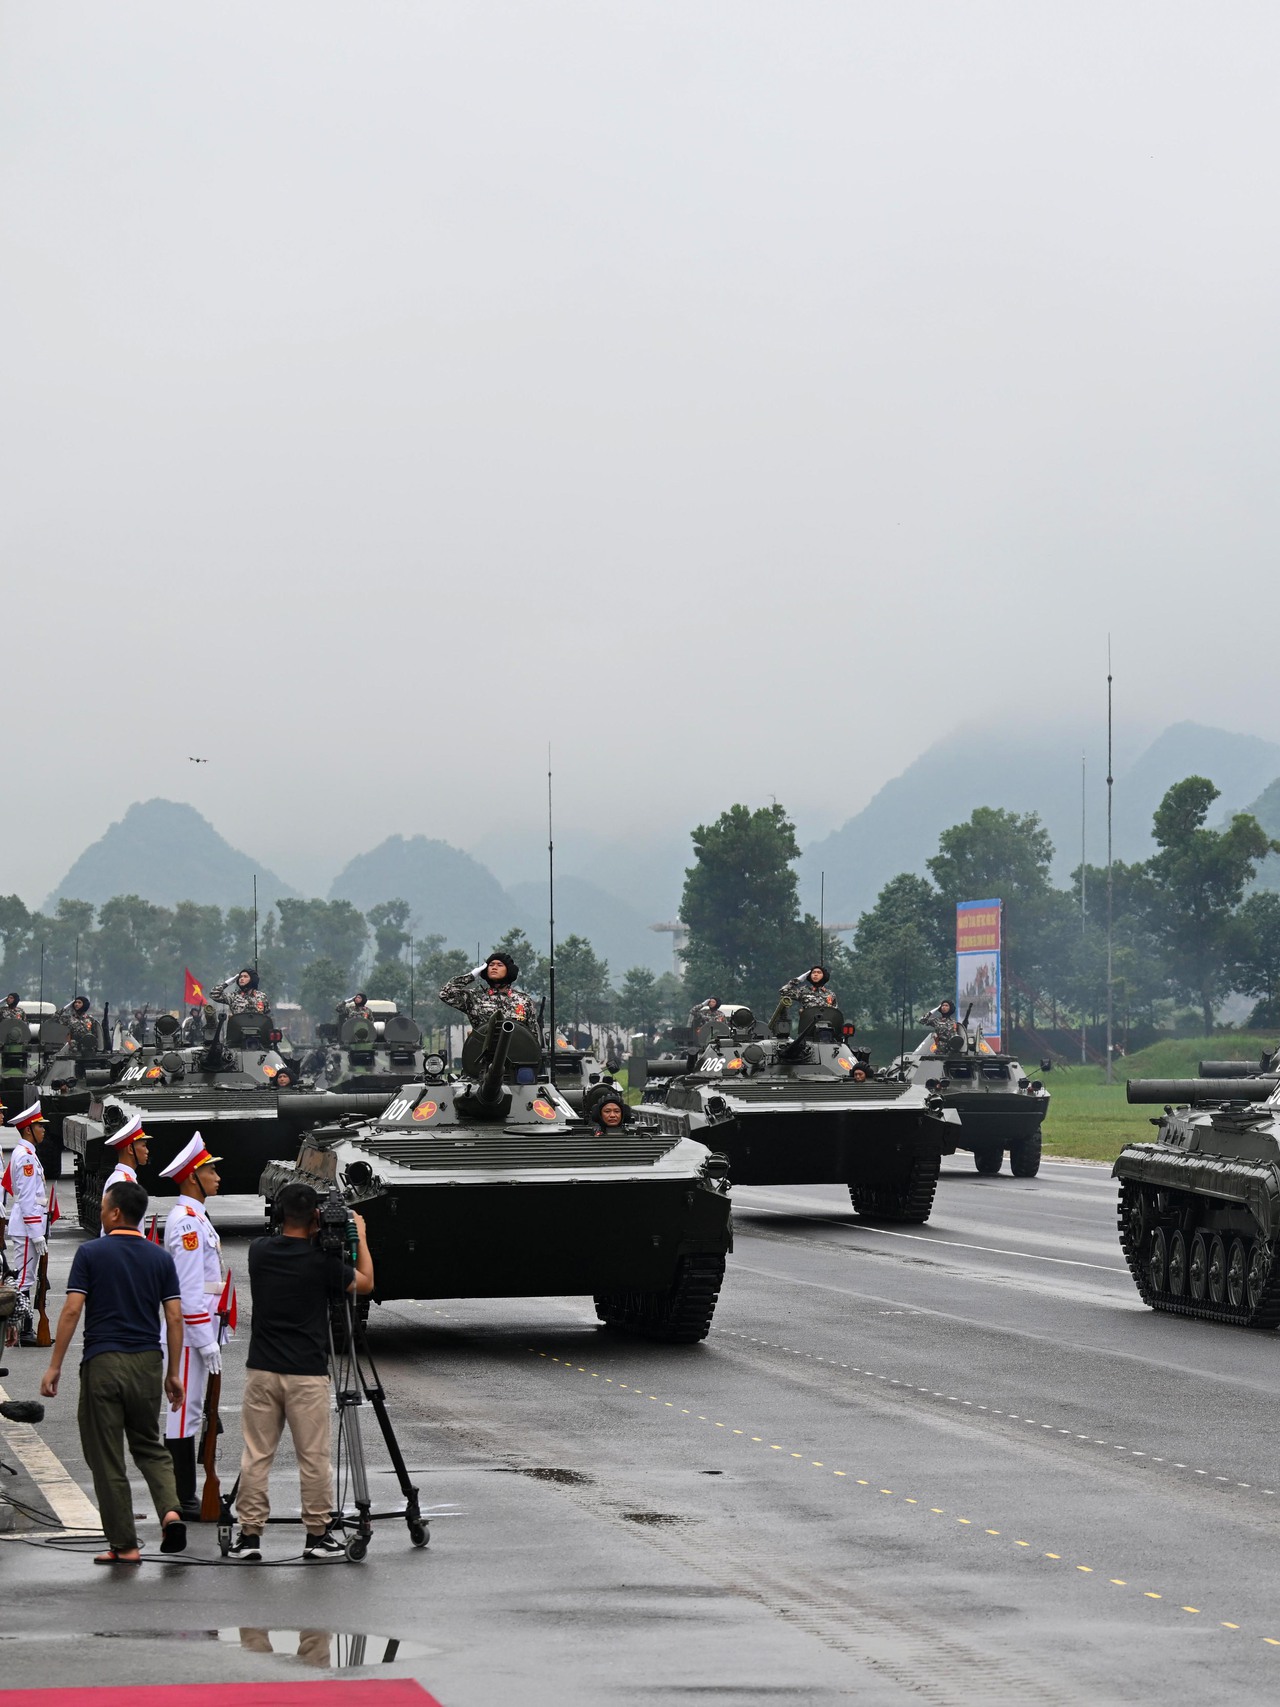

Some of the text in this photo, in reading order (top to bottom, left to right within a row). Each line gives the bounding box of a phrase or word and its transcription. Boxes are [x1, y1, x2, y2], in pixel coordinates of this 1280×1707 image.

[700, 1057, 726, 1072] 006
[121, 1066, 147, 1081] 004
[380, 1098, 415, 1121] 001
[182, 1223, 192, 1232] 10
